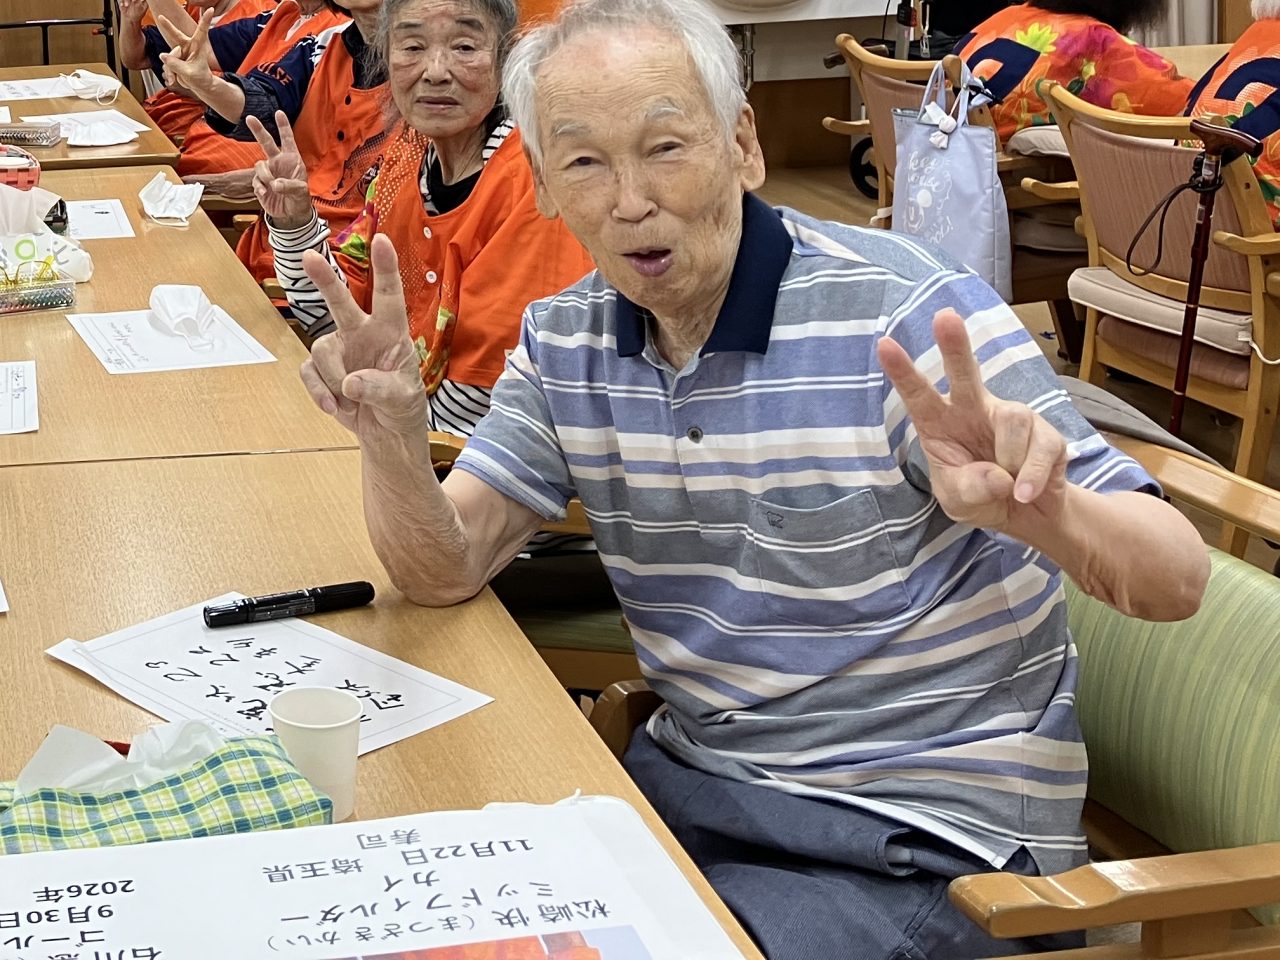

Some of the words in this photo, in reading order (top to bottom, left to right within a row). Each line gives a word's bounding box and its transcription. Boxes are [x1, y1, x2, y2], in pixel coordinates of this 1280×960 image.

[357, 828, 422, 850] 寿司
[402, 839, 534, 866] 11月22日
[262, 858, 364, 883] 埼玉県
[384, 870, 440, 892] カイ
[33, 879, 135, 903] 2026年
[281, 881, 553, 926] ミッドフィルダー
